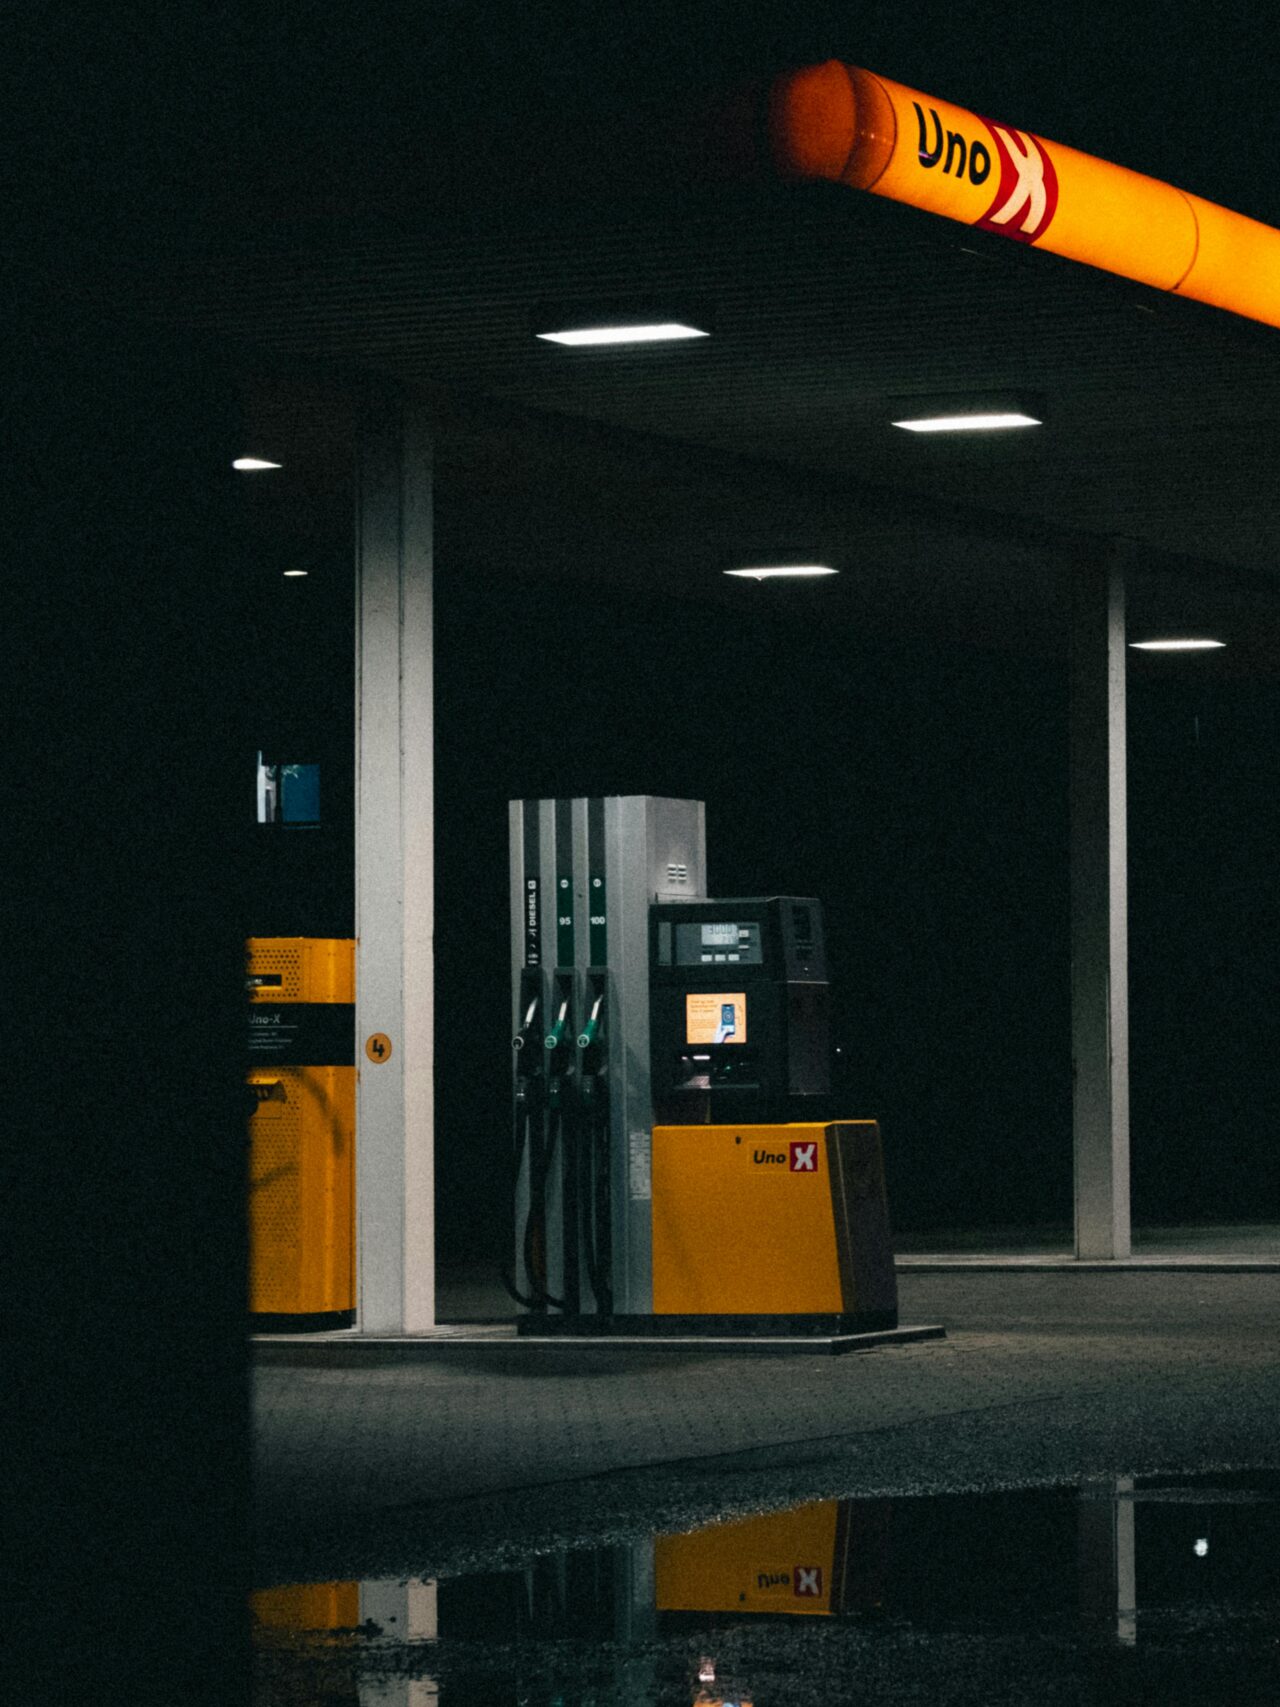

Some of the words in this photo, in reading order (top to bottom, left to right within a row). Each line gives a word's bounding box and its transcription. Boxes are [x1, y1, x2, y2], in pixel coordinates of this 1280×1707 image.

[912, 101, 991, 186] Uno
[989, 124, 1047, 235] X
[559, 917, 571, 925] 95
[590, 916, 605, 925] 100
[372, 1039, 385, 1058] 4
[753, 1150, 787, 1164] Uno
[793, 1144, 815, 1170] X
